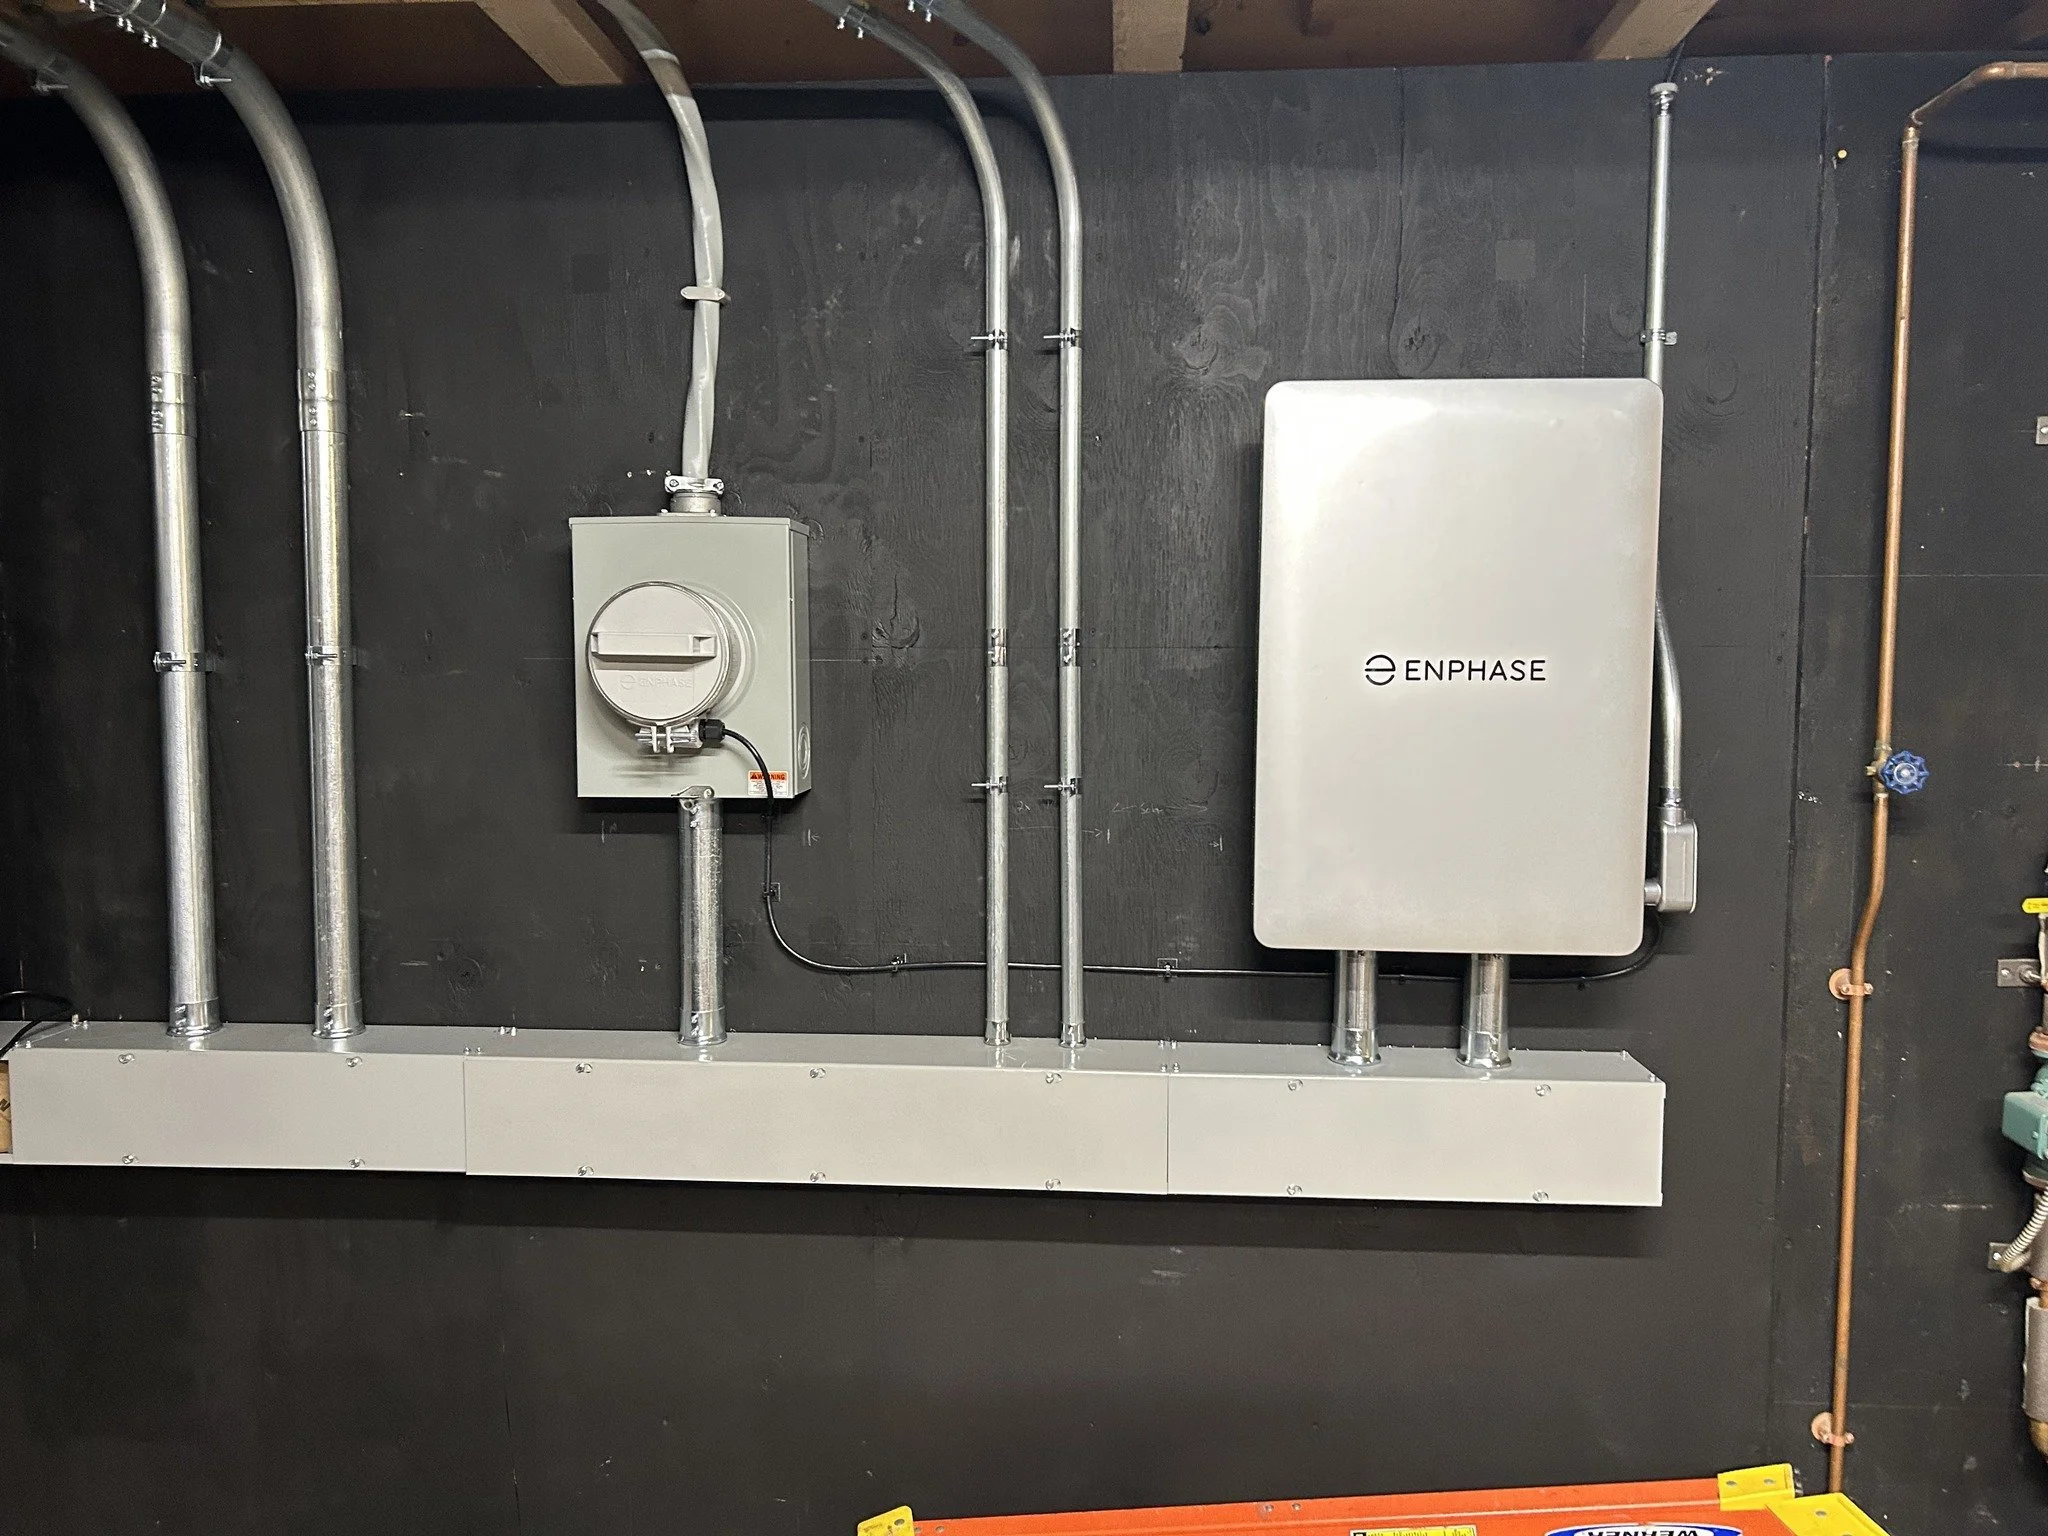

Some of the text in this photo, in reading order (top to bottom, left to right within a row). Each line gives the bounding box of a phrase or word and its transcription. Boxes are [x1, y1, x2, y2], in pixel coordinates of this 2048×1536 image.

[1405, 659, 1546, 681] ENPHASE
[640, 677, 693, 688] ENPHASE
[757, 773, 785, 781] WNING
